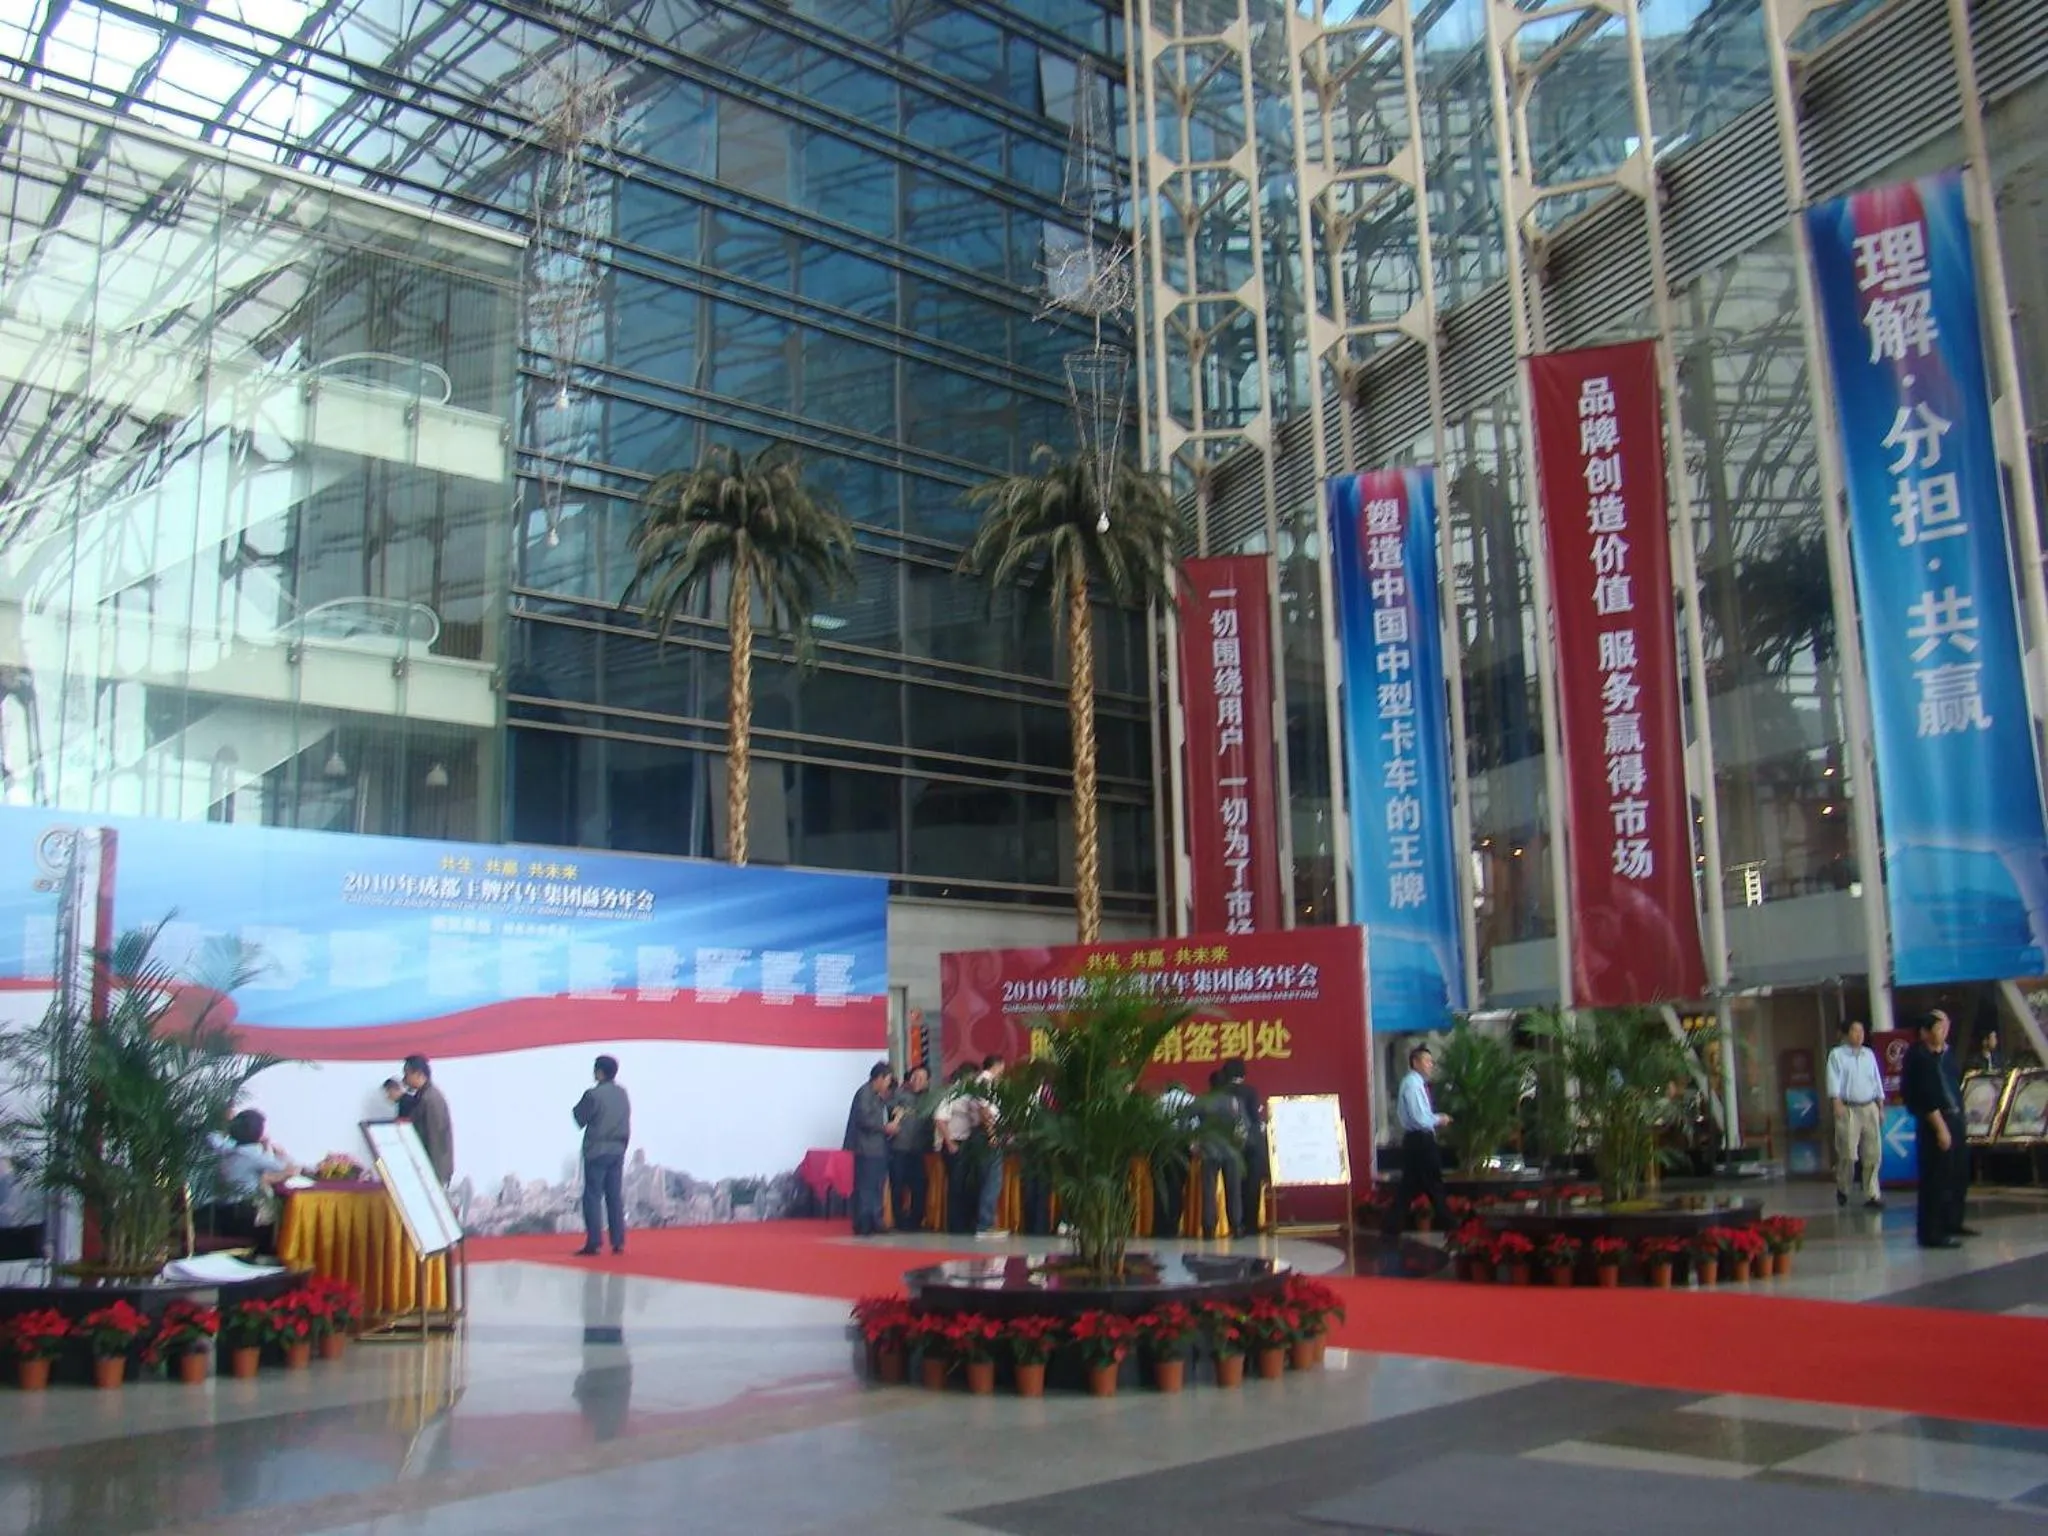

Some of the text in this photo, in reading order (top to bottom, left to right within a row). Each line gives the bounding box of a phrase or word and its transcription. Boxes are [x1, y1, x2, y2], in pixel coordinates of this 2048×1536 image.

[1208, 588, 1244, 756] 一切围绕用户
[1364, 498, 1426, 909] 塑造中国中型卡车的王牌
[1578, 376, 1653, 880] 品牌创造价值 服务赢得市场
